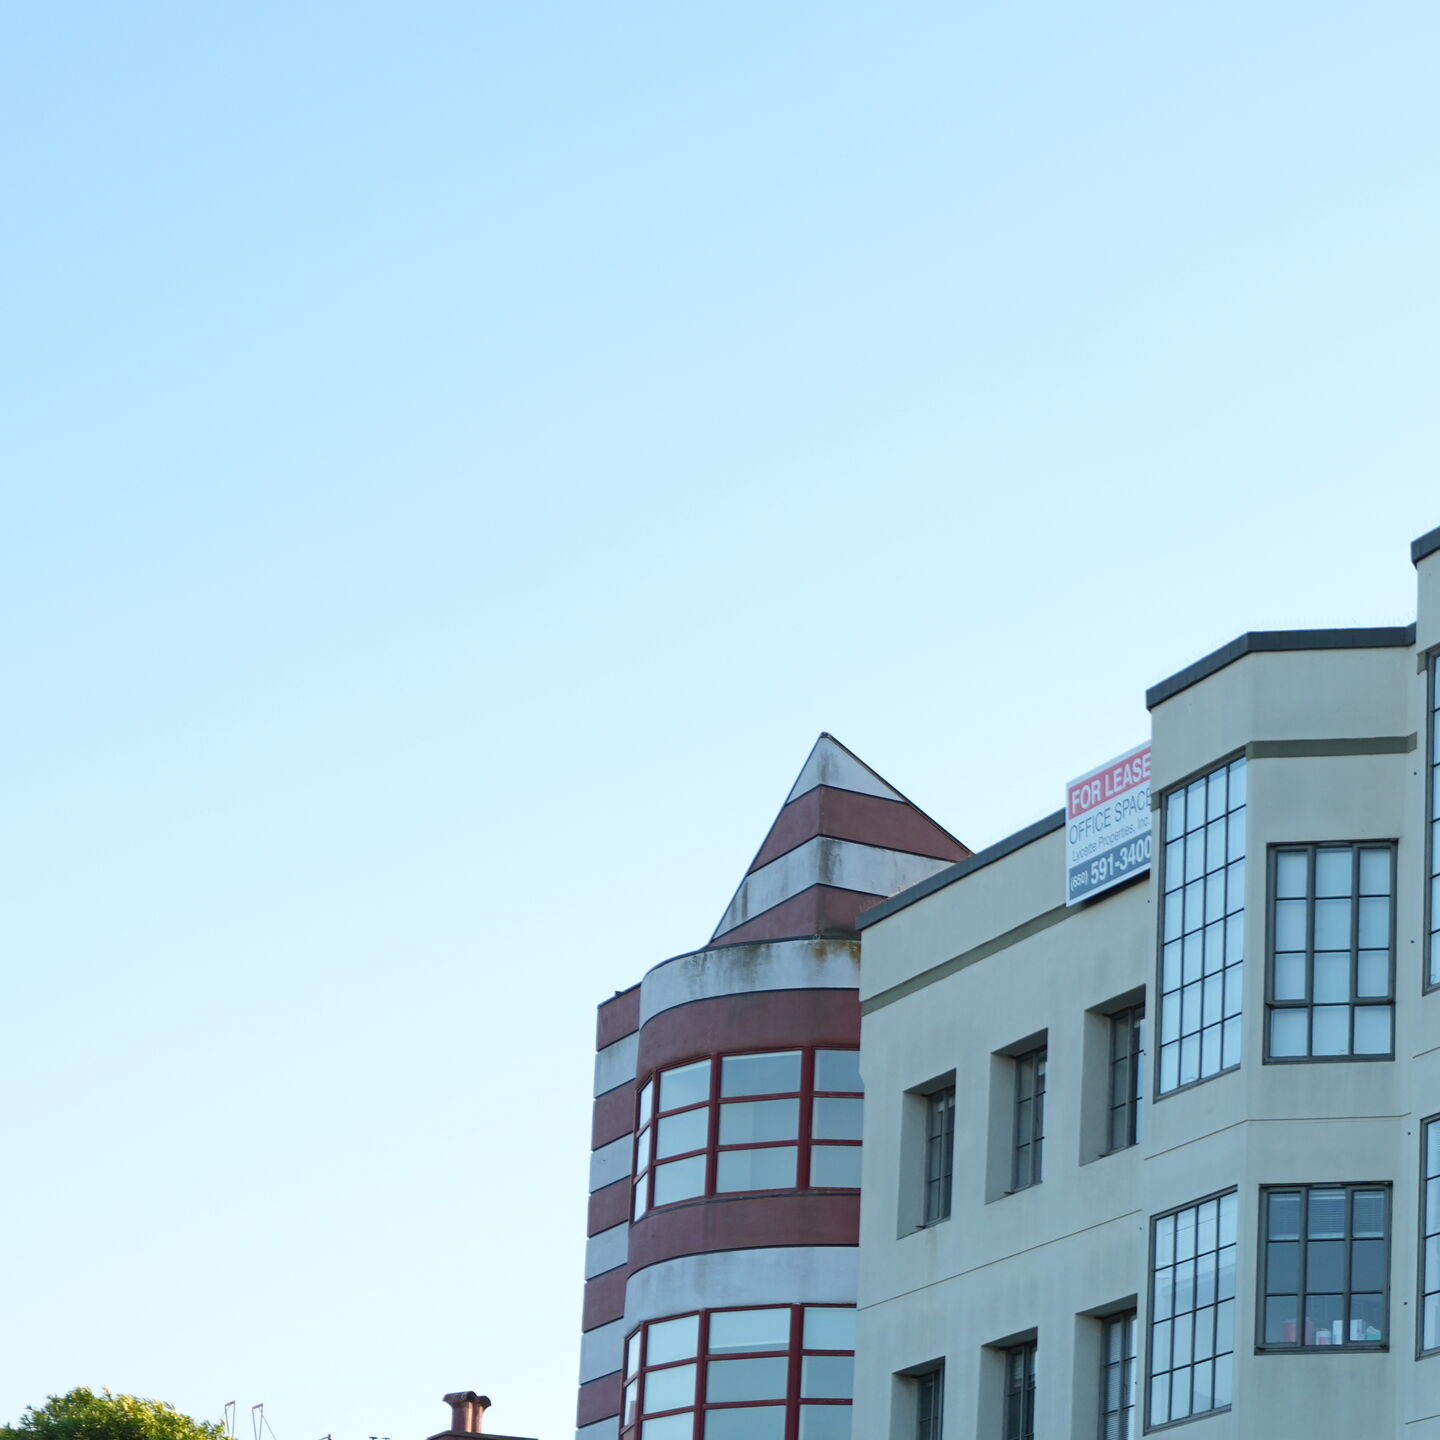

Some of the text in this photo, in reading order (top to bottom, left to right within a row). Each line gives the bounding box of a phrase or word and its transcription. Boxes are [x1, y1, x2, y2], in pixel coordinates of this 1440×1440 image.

[1072, 752, 1151, 814] FOR LEASE
[1069, 787, 1151, 845] OFFICE SPACE
[1090, 835, 1151, 885] 591-3400
